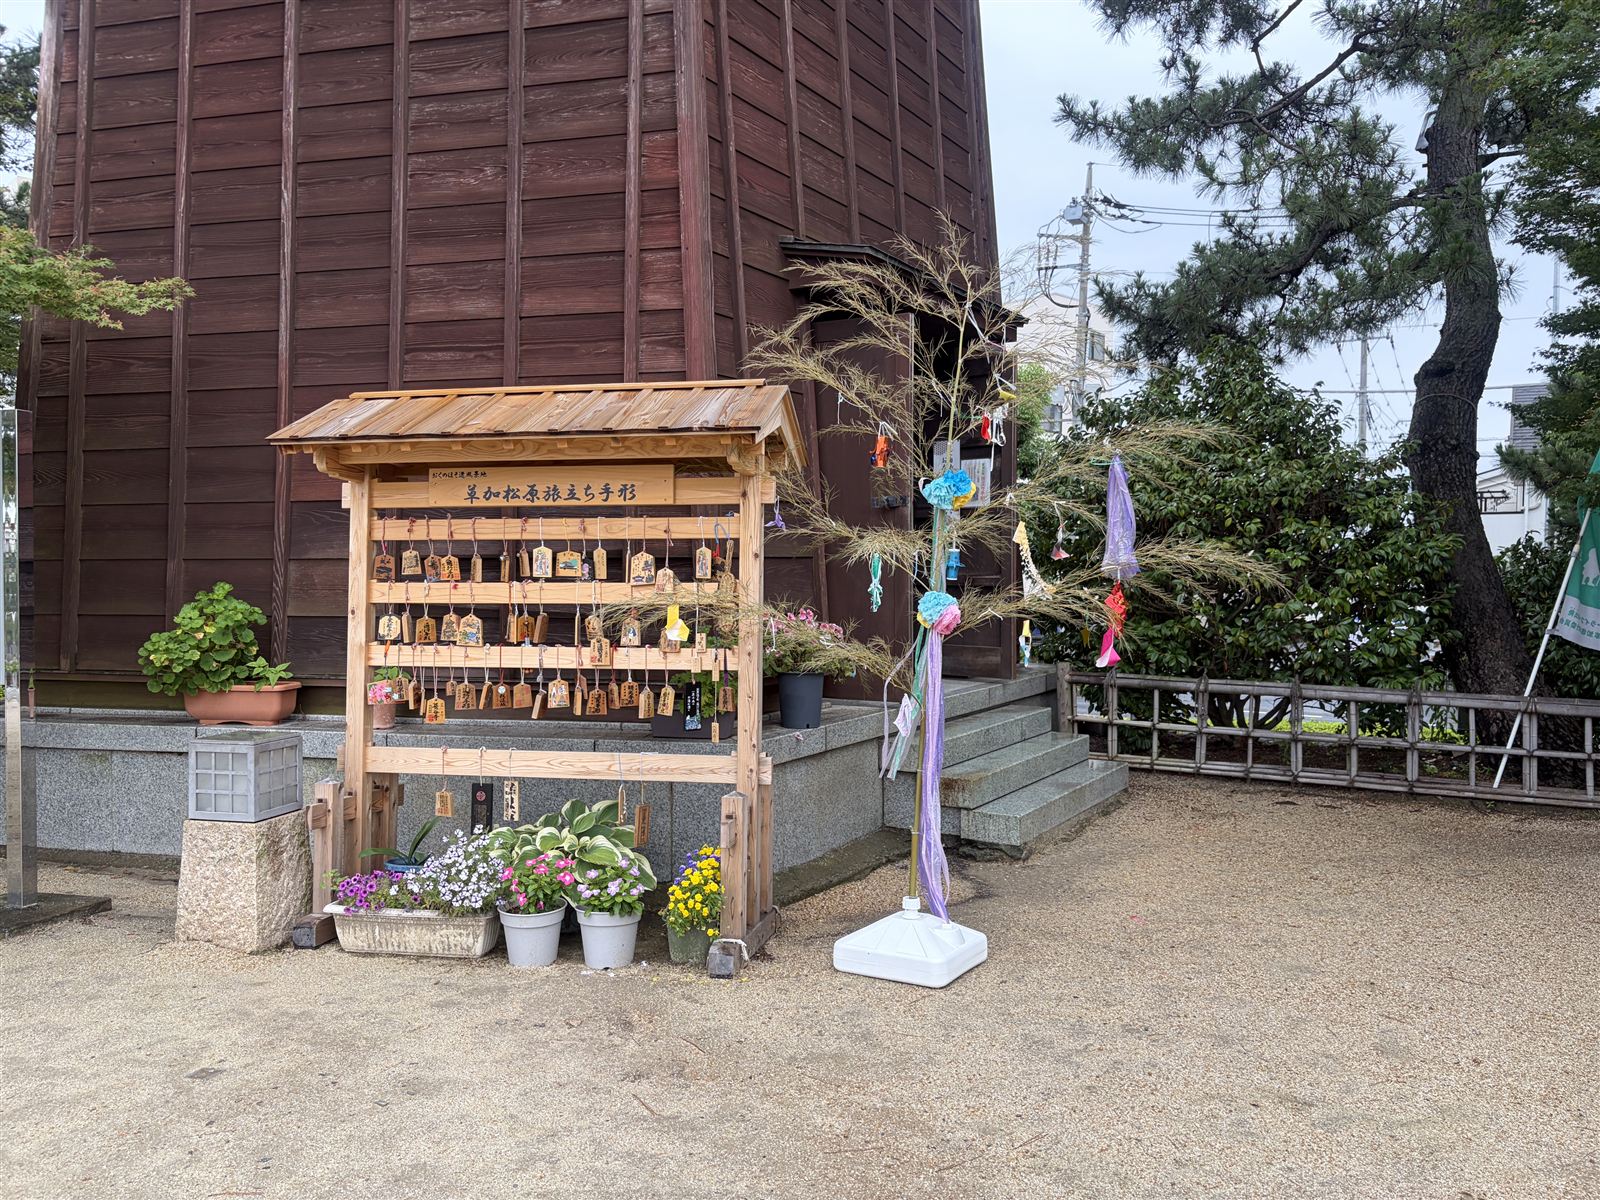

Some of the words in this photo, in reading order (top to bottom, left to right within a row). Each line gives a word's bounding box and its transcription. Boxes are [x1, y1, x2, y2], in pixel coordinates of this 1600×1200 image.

[464, 483, 637, 505] 草加松原旅立ち手形
